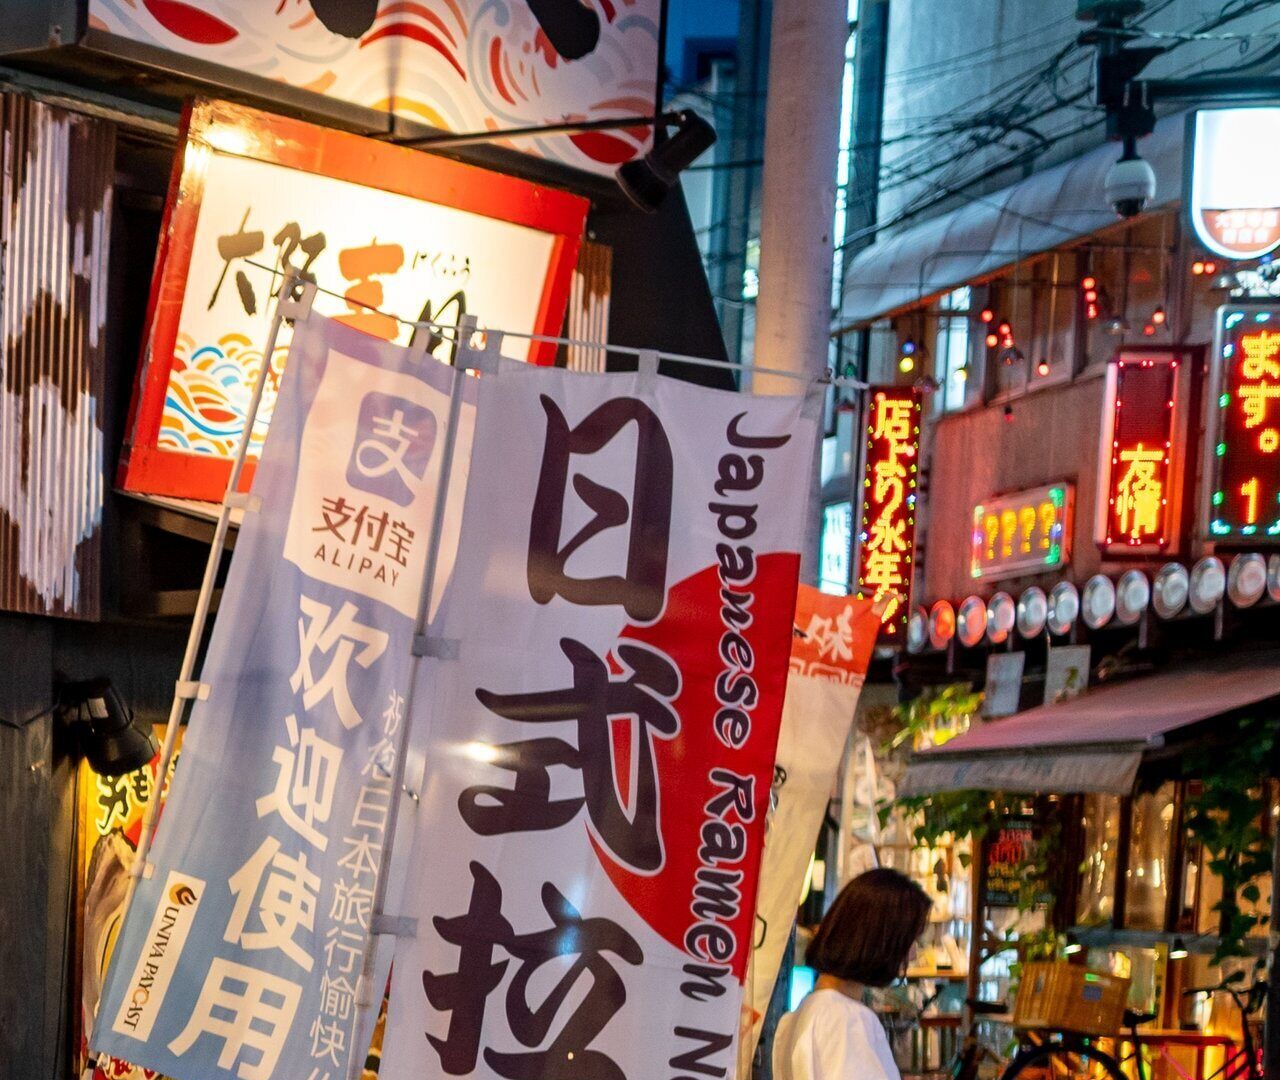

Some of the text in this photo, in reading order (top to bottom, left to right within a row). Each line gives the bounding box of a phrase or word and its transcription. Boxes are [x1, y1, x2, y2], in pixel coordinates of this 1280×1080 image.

[312, 496, 416, 570] 支付宝
[313, 543, 400, 588] ALIPAY
[711, 411, 791, 748] Japanese
[684, 768, 765, 1004] Ramen
[149, 906, 180, 958] UNIVA
